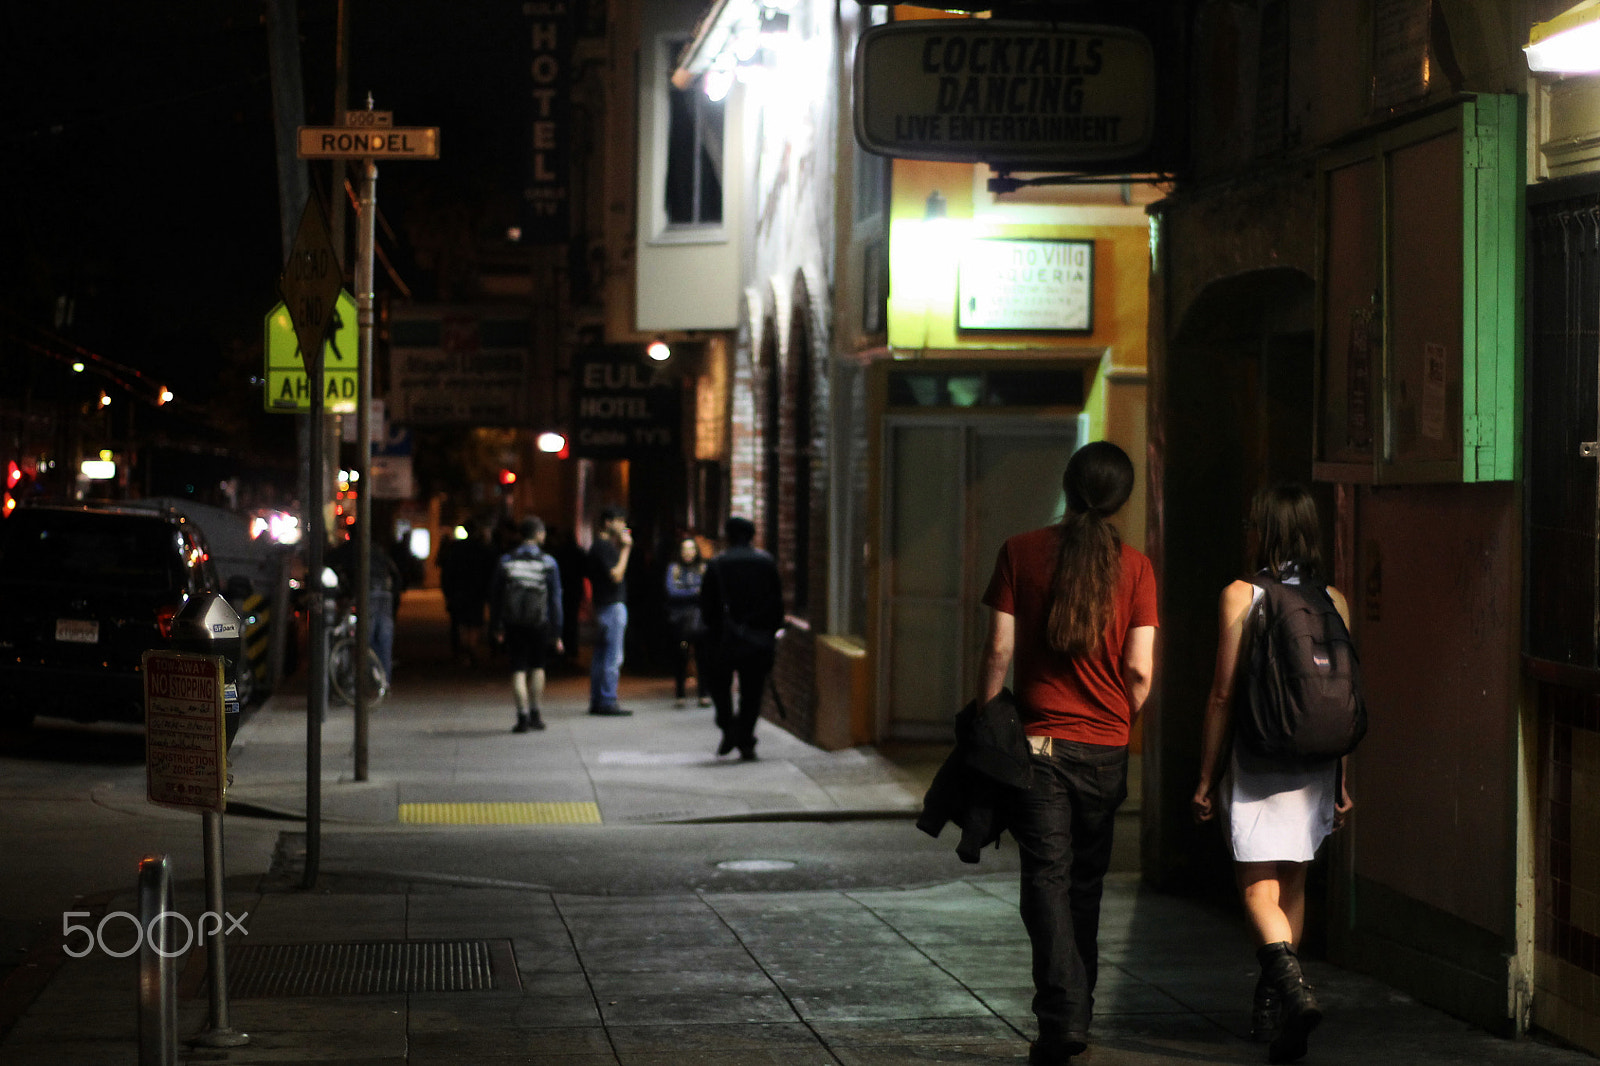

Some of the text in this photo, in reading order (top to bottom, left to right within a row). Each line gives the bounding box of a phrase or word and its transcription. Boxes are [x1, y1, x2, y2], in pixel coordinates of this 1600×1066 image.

[921, 36, 1104, 75] COCKTAILS
[530, 22, 559, 182] HOTEL
[935, 76, 1085, 114] DANCING
[894, 114, 1122, 142] LIVE ENTERTAINMENT
[321, 134, 415, 152] RONDEL
[1043, 247, 1084, 267] Villa
[281, 377, 356, 399] AHAD
[580, 396, 654, 418] HOTEL
[151, 672, 169, 696] NO
[170, 676, 213, 699] STOPPING
[151, 751, 215, 767] CONSTRUCTION
[173, 765, 195, 776] ZONE
